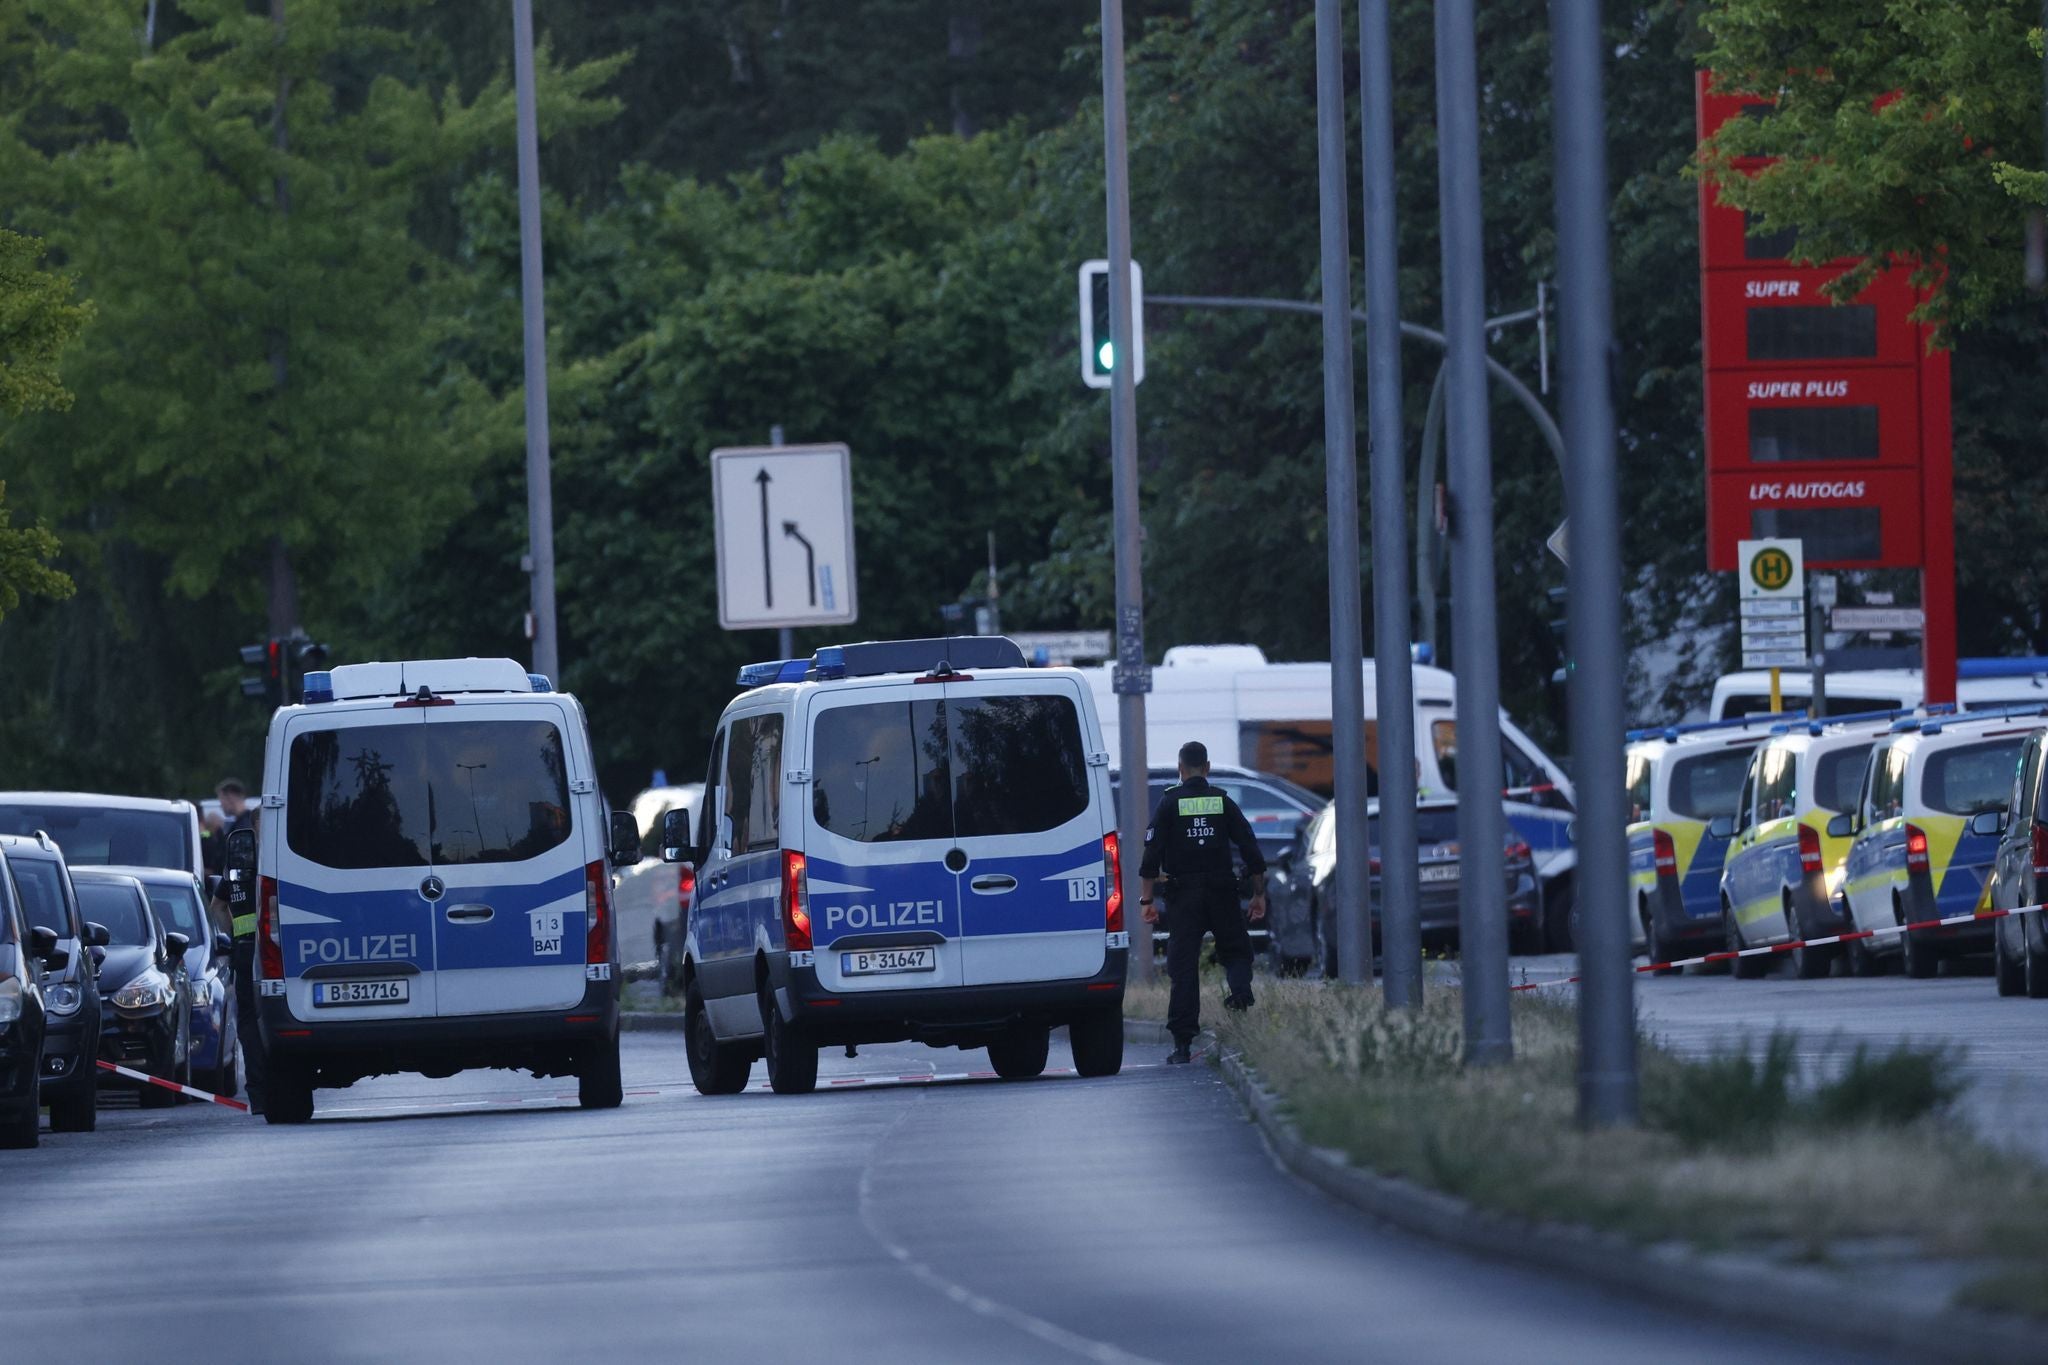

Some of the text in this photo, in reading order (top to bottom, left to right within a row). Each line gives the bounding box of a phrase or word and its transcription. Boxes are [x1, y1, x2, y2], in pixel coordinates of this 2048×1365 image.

[1745, 280, 1800, 298] SUPER
[1748, 380, 1848, 398] SUPER PLUS
[1749, 481, 1865, 500] LPG AUTOGAS
[1180, 797, 1224, 814] POLIZEI
[1193, 818, 1207, 827] BE
[1187, 827, 1215, 838] 13102
[1073, 880, 1097, 899] 13
[826, 900, 944, 930] POLIZEI
[299, 933, 417, 964] POLIZEI
[534, 938, 560, 952] BAT
